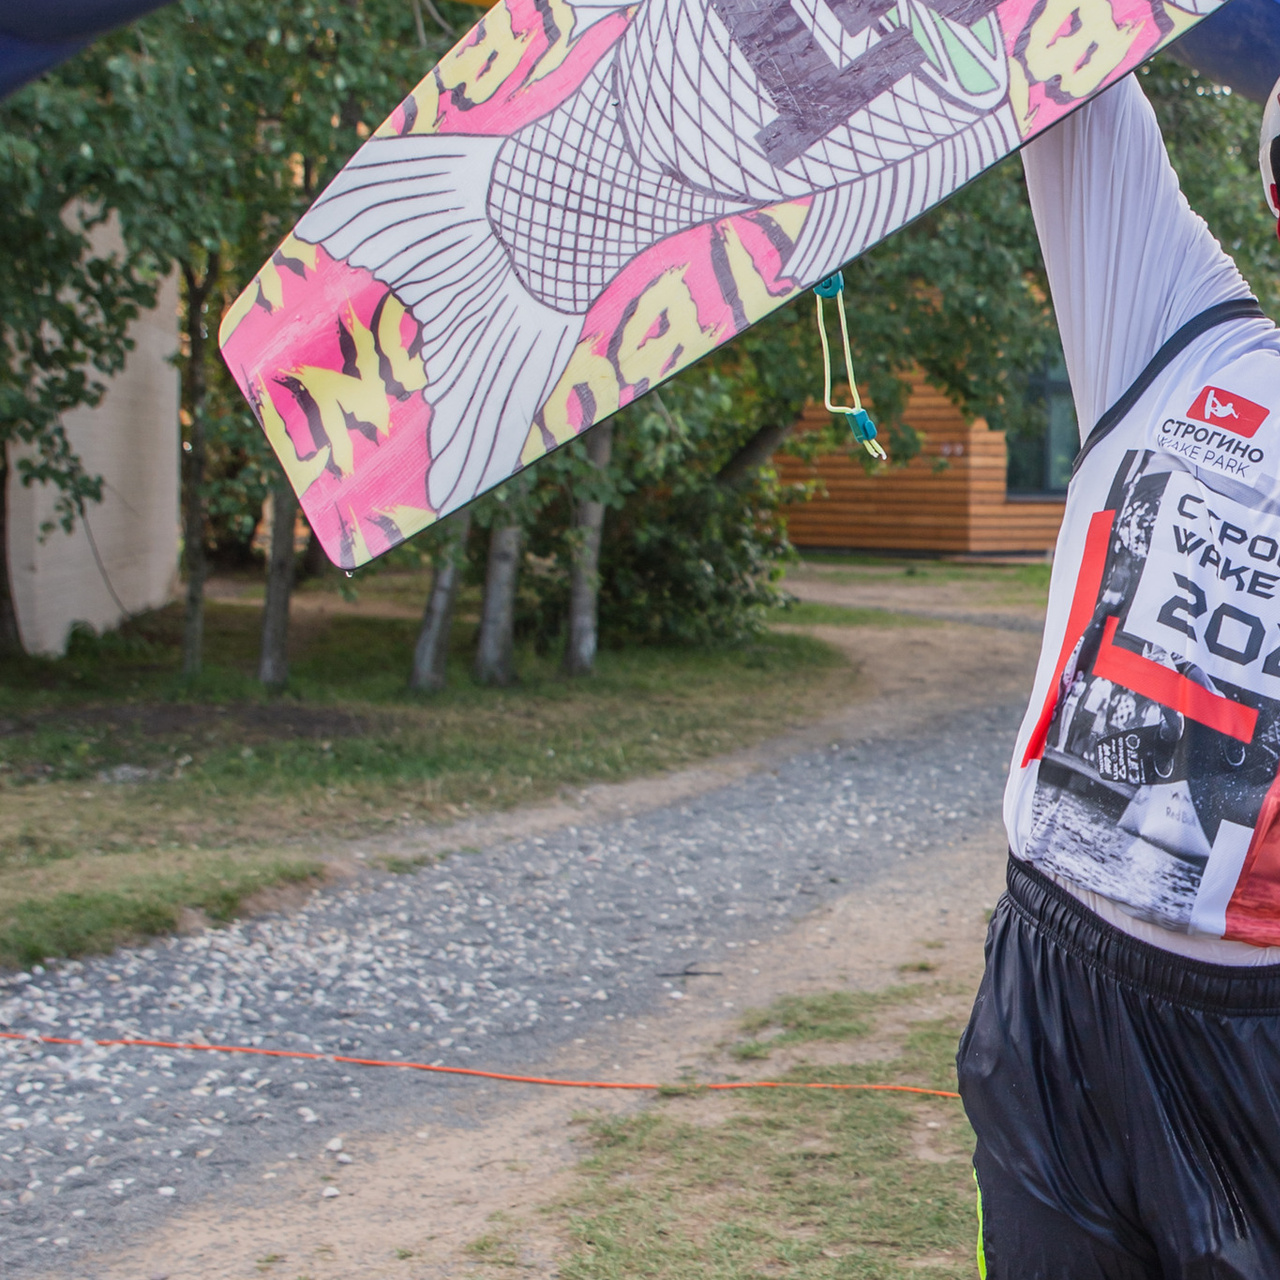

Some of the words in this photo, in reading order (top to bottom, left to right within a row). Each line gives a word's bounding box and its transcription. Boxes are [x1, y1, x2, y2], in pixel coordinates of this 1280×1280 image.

[1156, 434, 1203, 461] WAKE
[1202, 449, 1250, 478] PARK
[1161, 418, 1265, 464] СТРОГИНО
